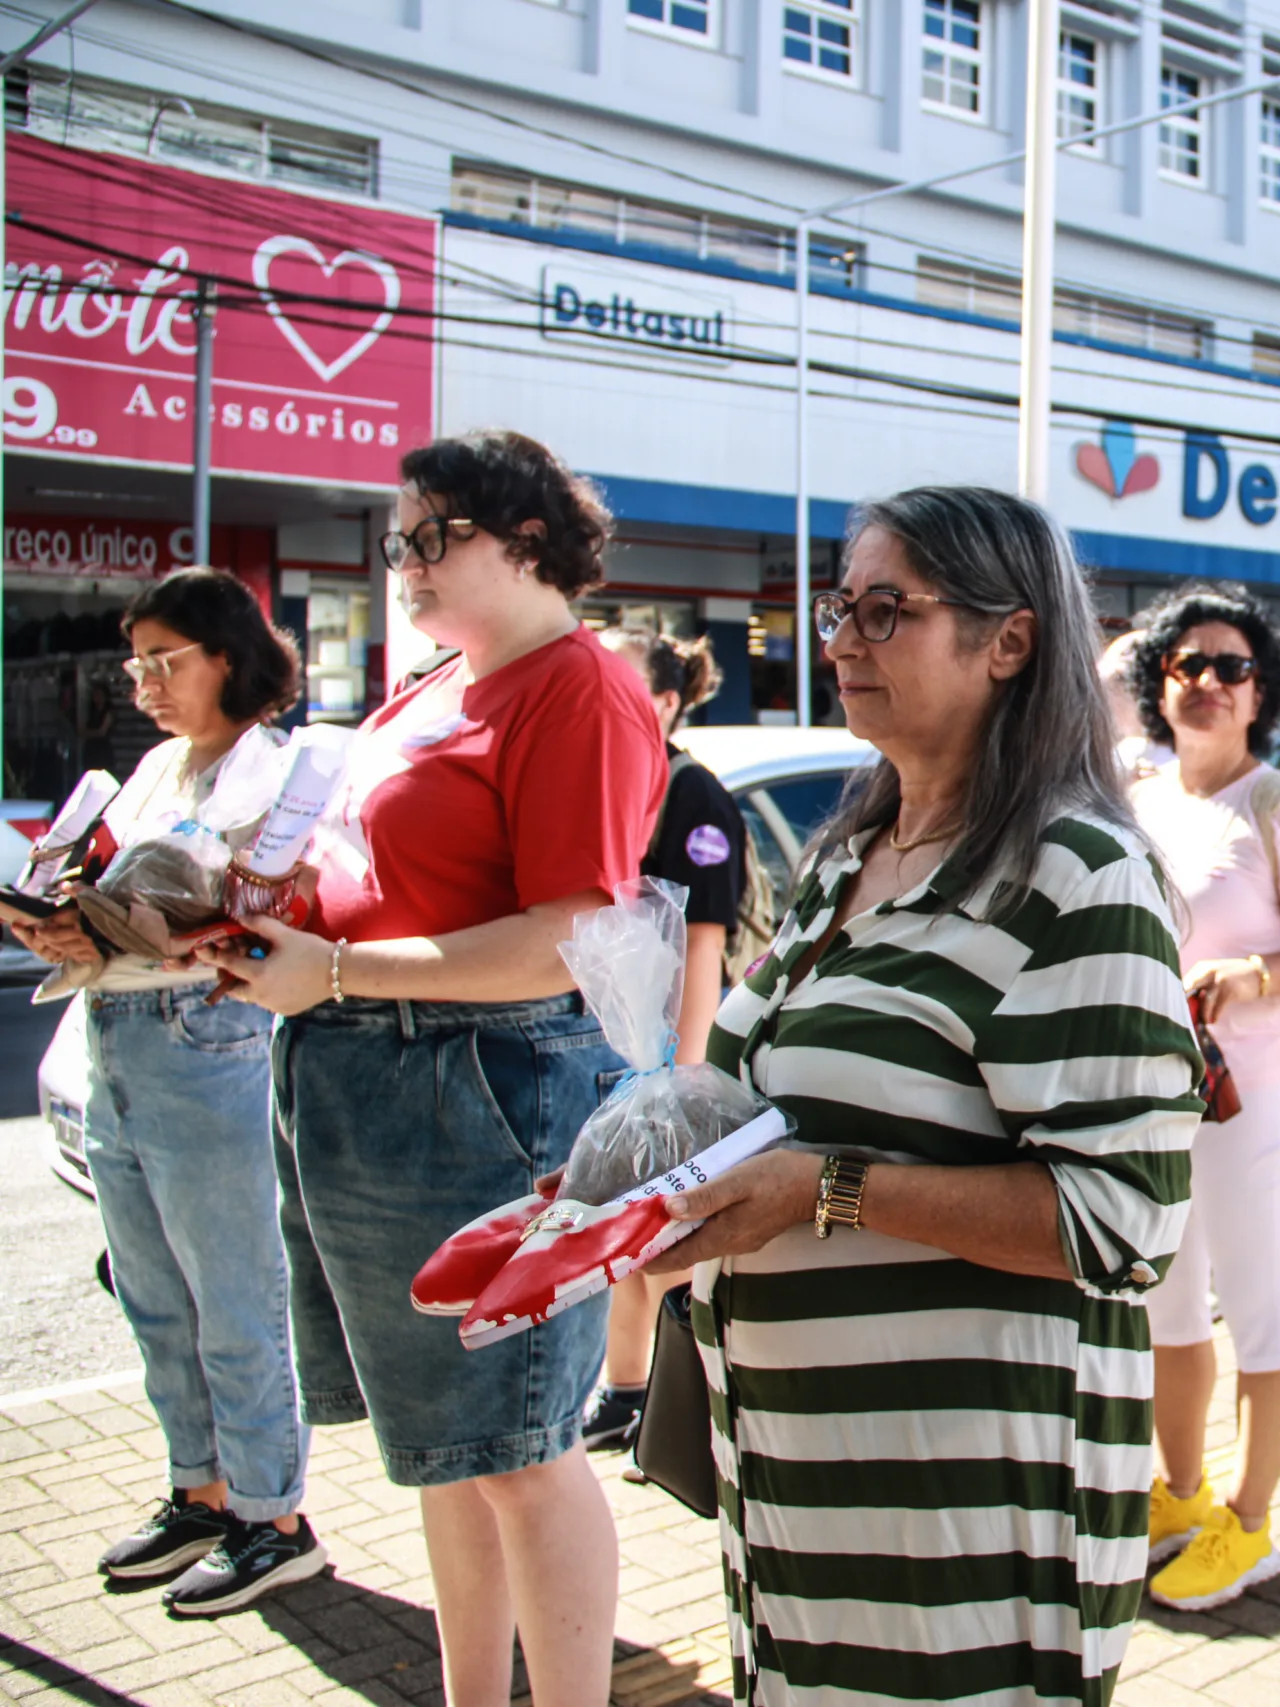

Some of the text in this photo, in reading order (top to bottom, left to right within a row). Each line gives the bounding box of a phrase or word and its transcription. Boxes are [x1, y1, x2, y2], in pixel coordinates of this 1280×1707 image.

[556, 282, 723, 346] Deltasul
[122, 383, 399, 448] Acssórios
[80, 524, 157, 567] único
